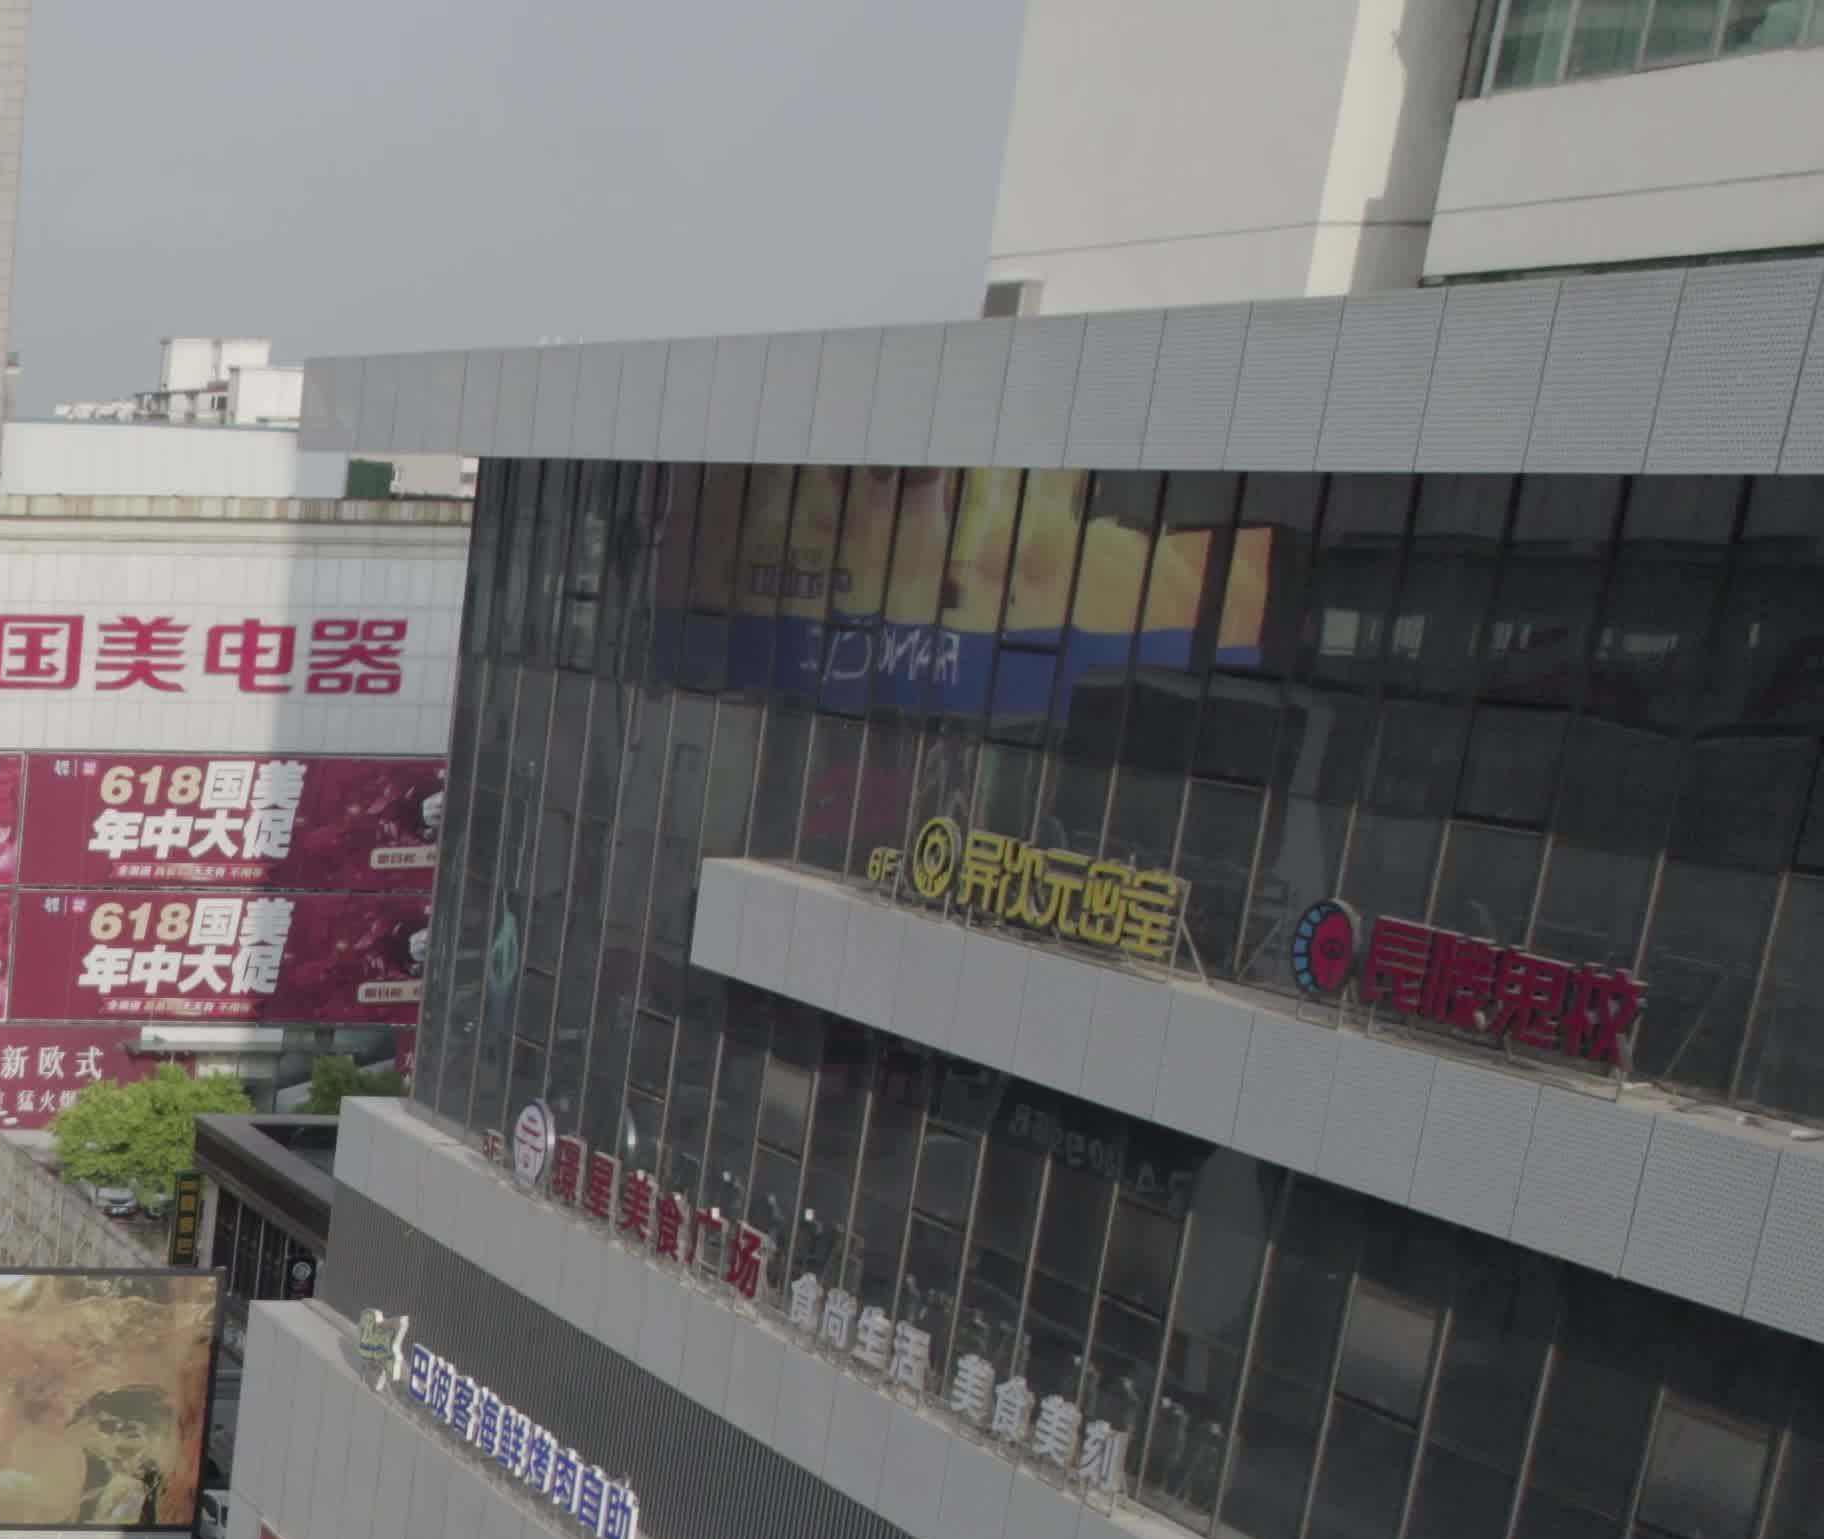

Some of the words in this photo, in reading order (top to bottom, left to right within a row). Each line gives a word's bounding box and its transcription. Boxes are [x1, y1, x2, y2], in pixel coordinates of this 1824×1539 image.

[100, 760, 307, 809] 618国美
[88, 809, 299, 859] 年中大促
[90, 898, 295, 945] 618国美
[78, 944, 289, 994] 年中大促
